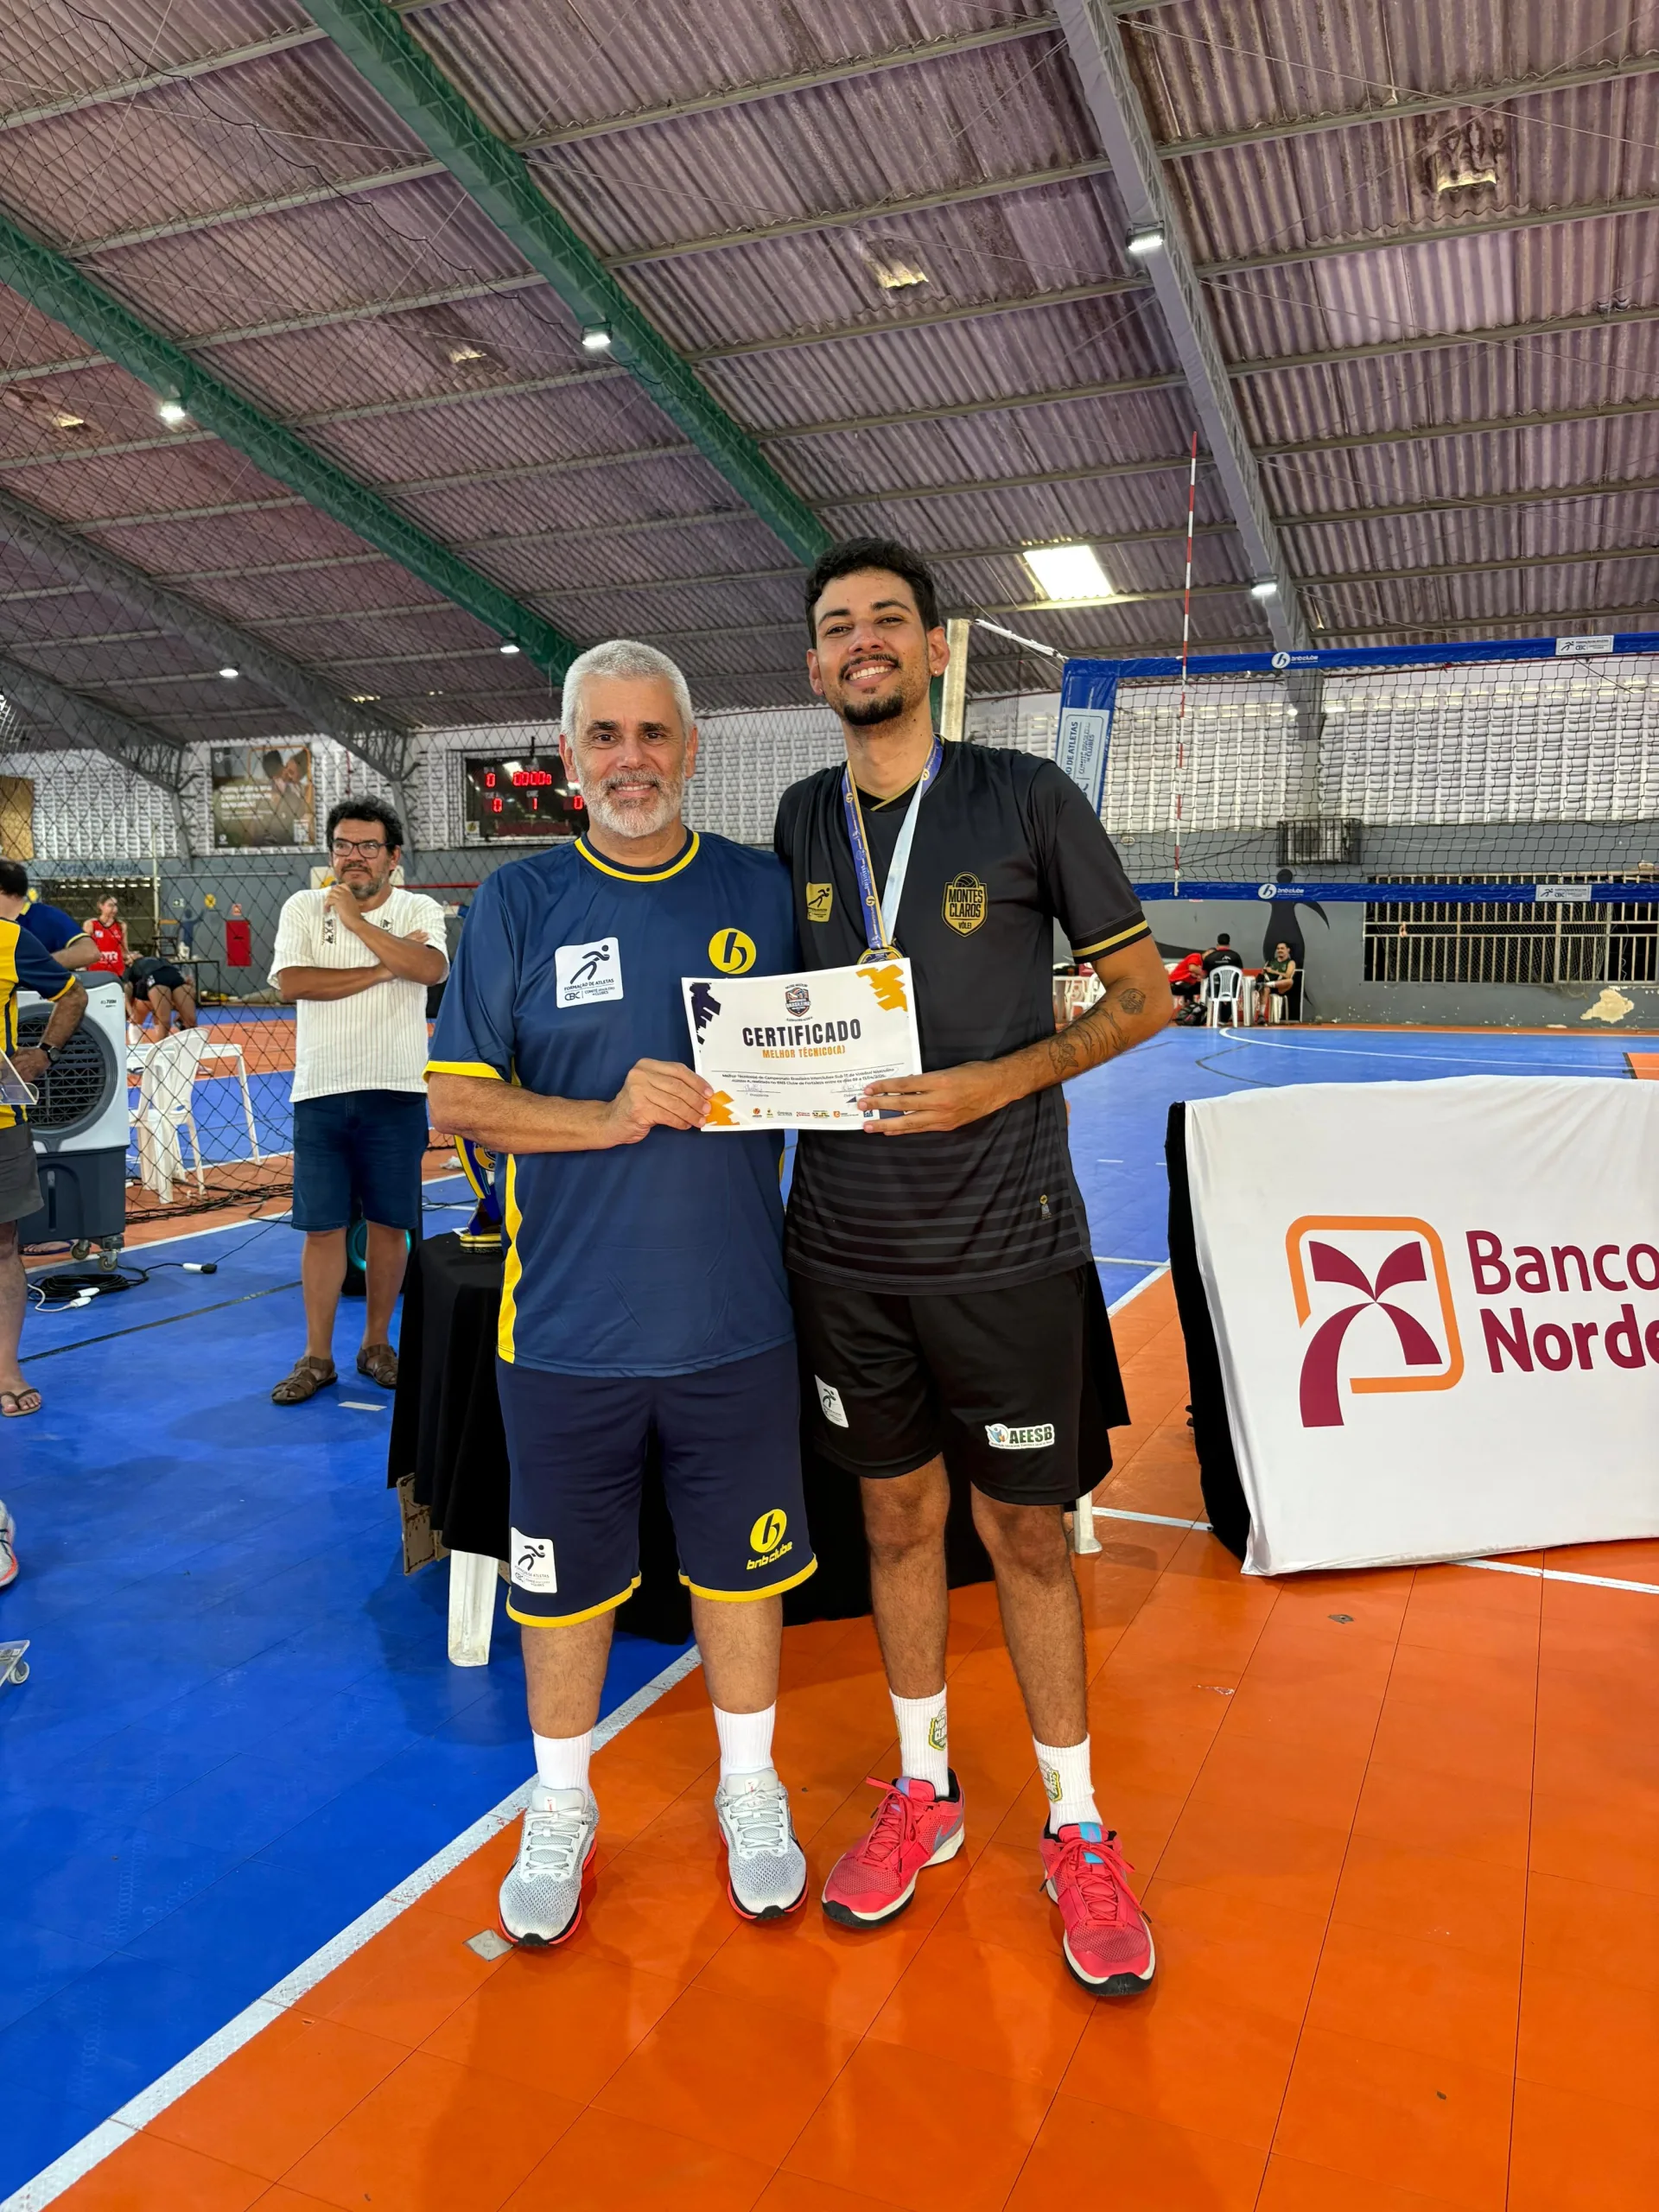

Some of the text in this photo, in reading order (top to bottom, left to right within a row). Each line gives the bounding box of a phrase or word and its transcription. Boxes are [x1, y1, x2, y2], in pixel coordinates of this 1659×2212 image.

[1068, 721, 1078, 753] ATLETAS
[1066, 754, 1074, 766] DE
[486, 772, 496, 787] 0
[573, 795, 583, 810] 0
[949, 888, 983, 903] MONTES
[950, 903, 981, 918] CLAROS
[564, 982, 588, 991] FORMAÇÃO
[742, 1019, 861, 1046] CERTIFICADO
[762, 1045, 846, 1058] MELHOR TÉCNICO(A)
[1465, 1230, 1659, 1295] Banco
[1009, 1426, 1052, 1444] AEESB
